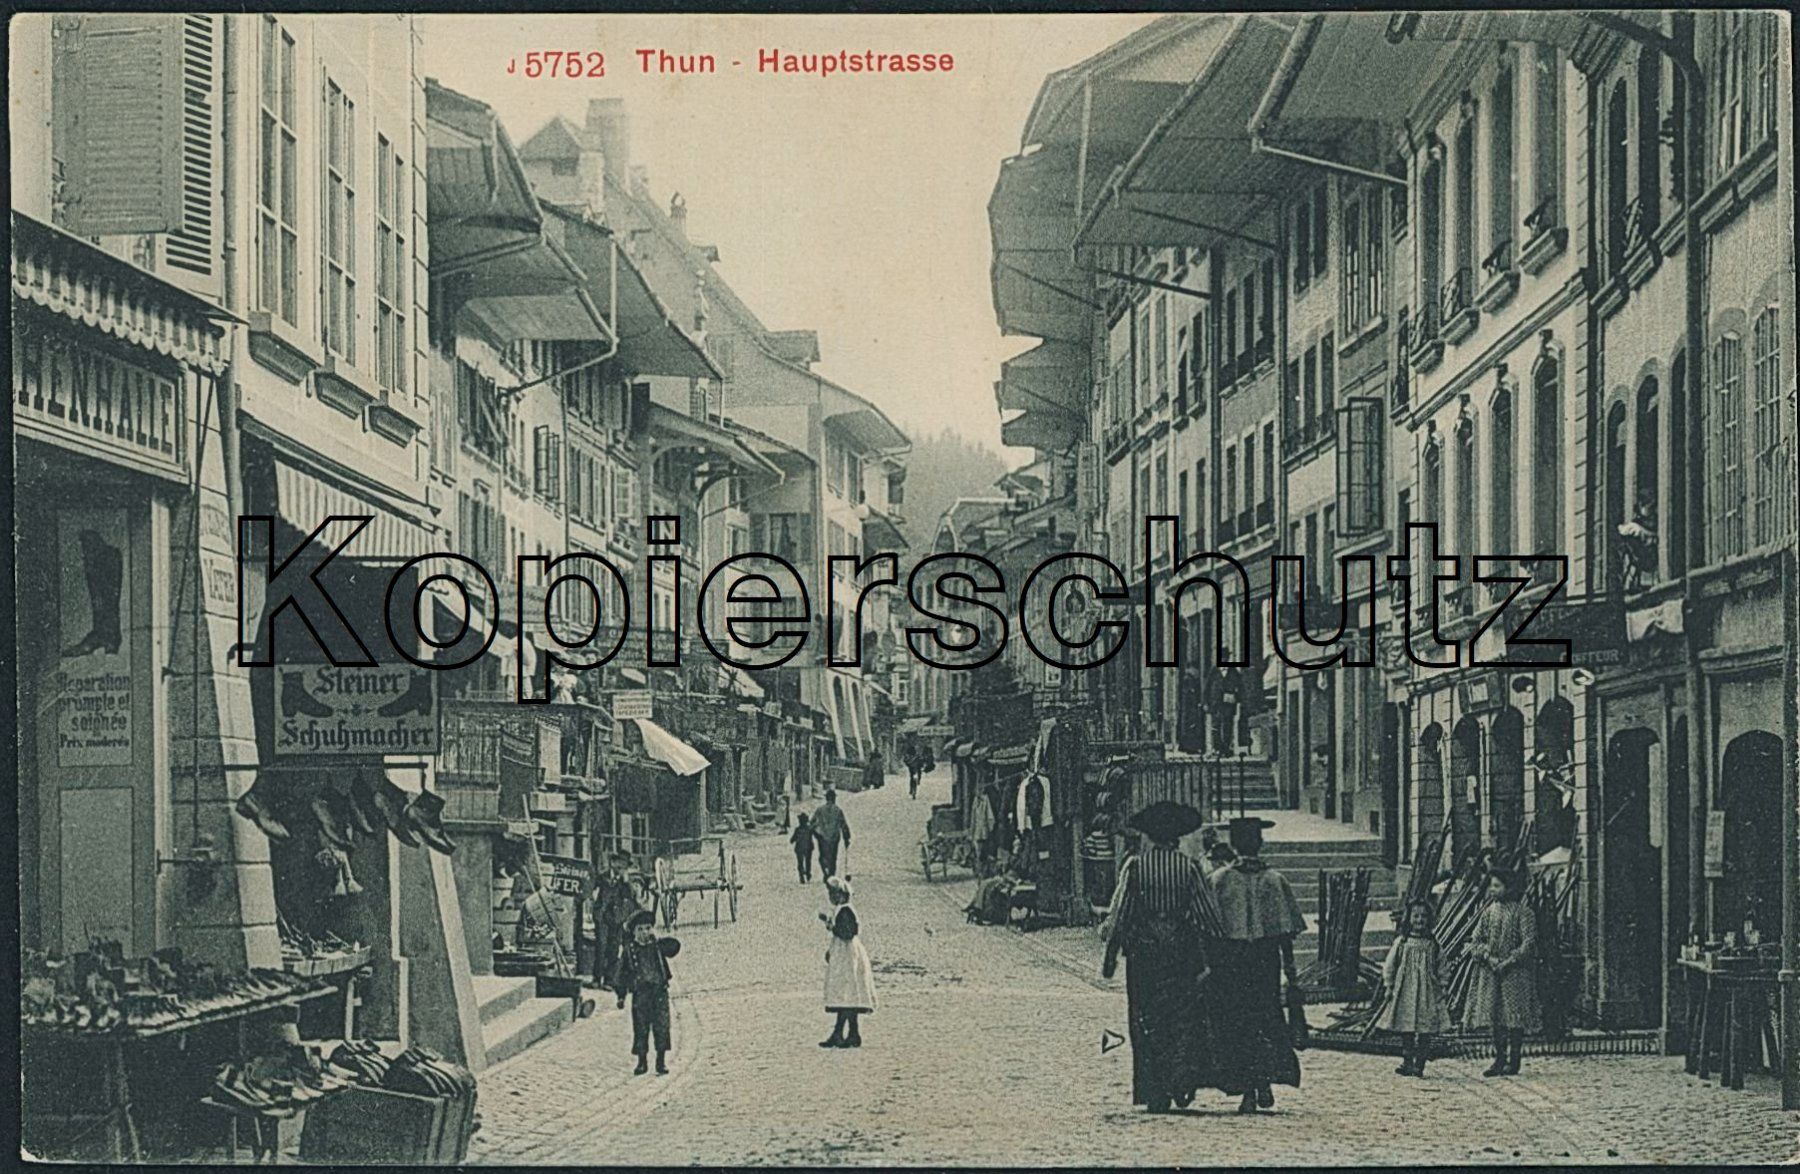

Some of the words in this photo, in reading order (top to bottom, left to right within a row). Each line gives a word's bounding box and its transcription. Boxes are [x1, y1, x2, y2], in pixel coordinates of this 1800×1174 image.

[312, 665, 404, 696] Steiner
[59, 733, 83, 748] Prix
[277, 719, 434, 751] Schuhmacher
